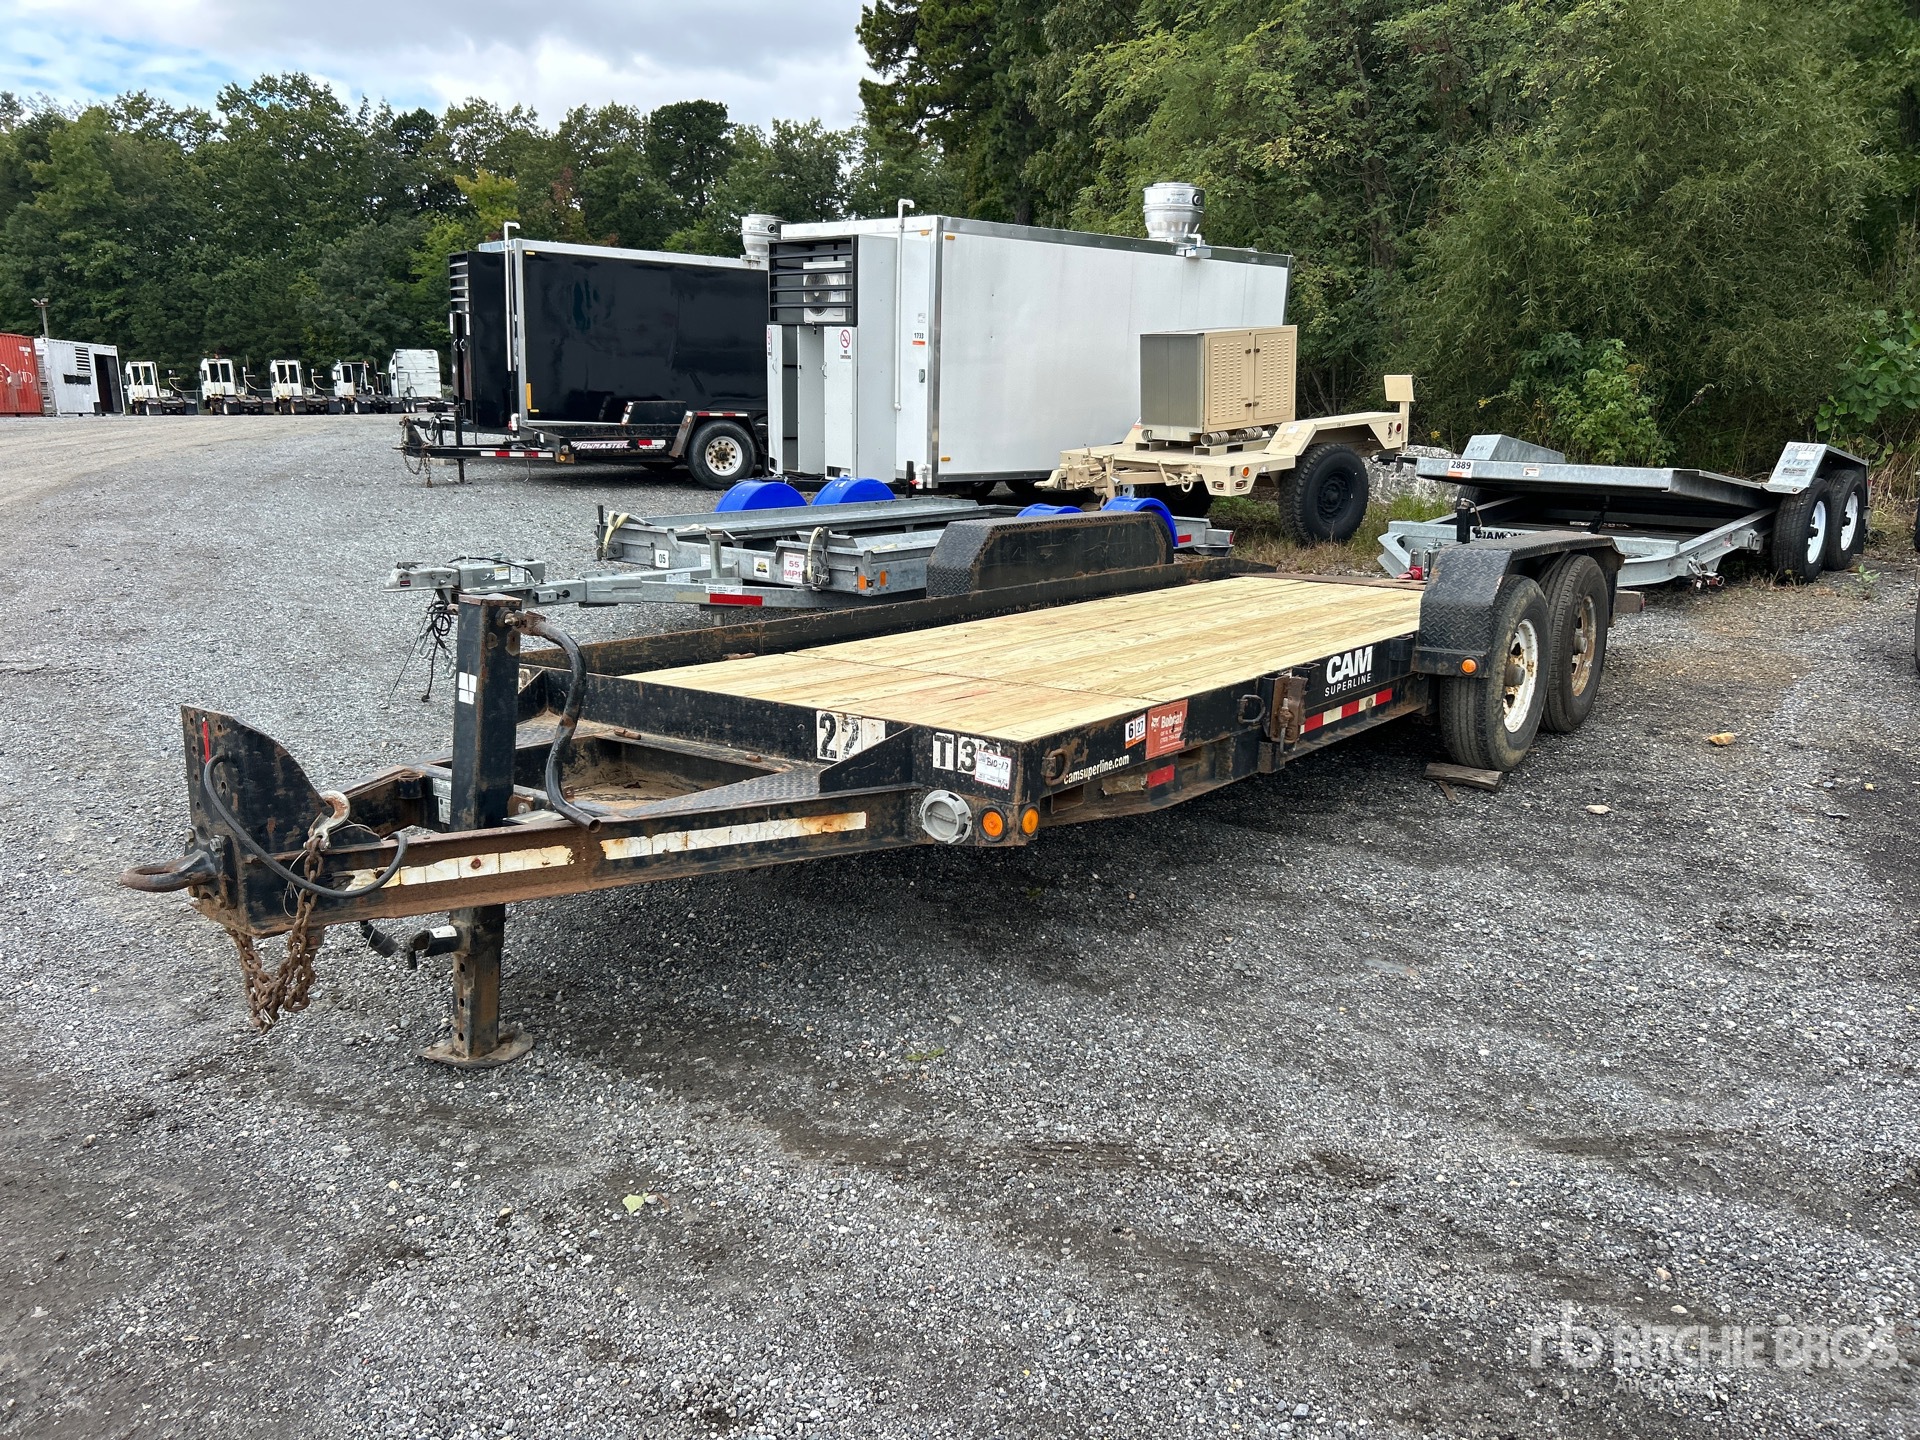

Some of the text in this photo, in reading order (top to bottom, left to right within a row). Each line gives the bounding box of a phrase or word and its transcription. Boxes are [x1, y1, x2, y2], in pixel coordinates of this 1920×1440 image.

[1450, 460, 1472, 470] 2889
[658, 553, 667, 564] 05
[788, 560, 800, 568] 55
[1326, 645, 1373, 684] CAM
[1324, 672, 1372, 697] SUPERLINE
[1160, 711, 1183, 729] Bobcat
[1063, 754, 1130, 785] camsuperline.com
